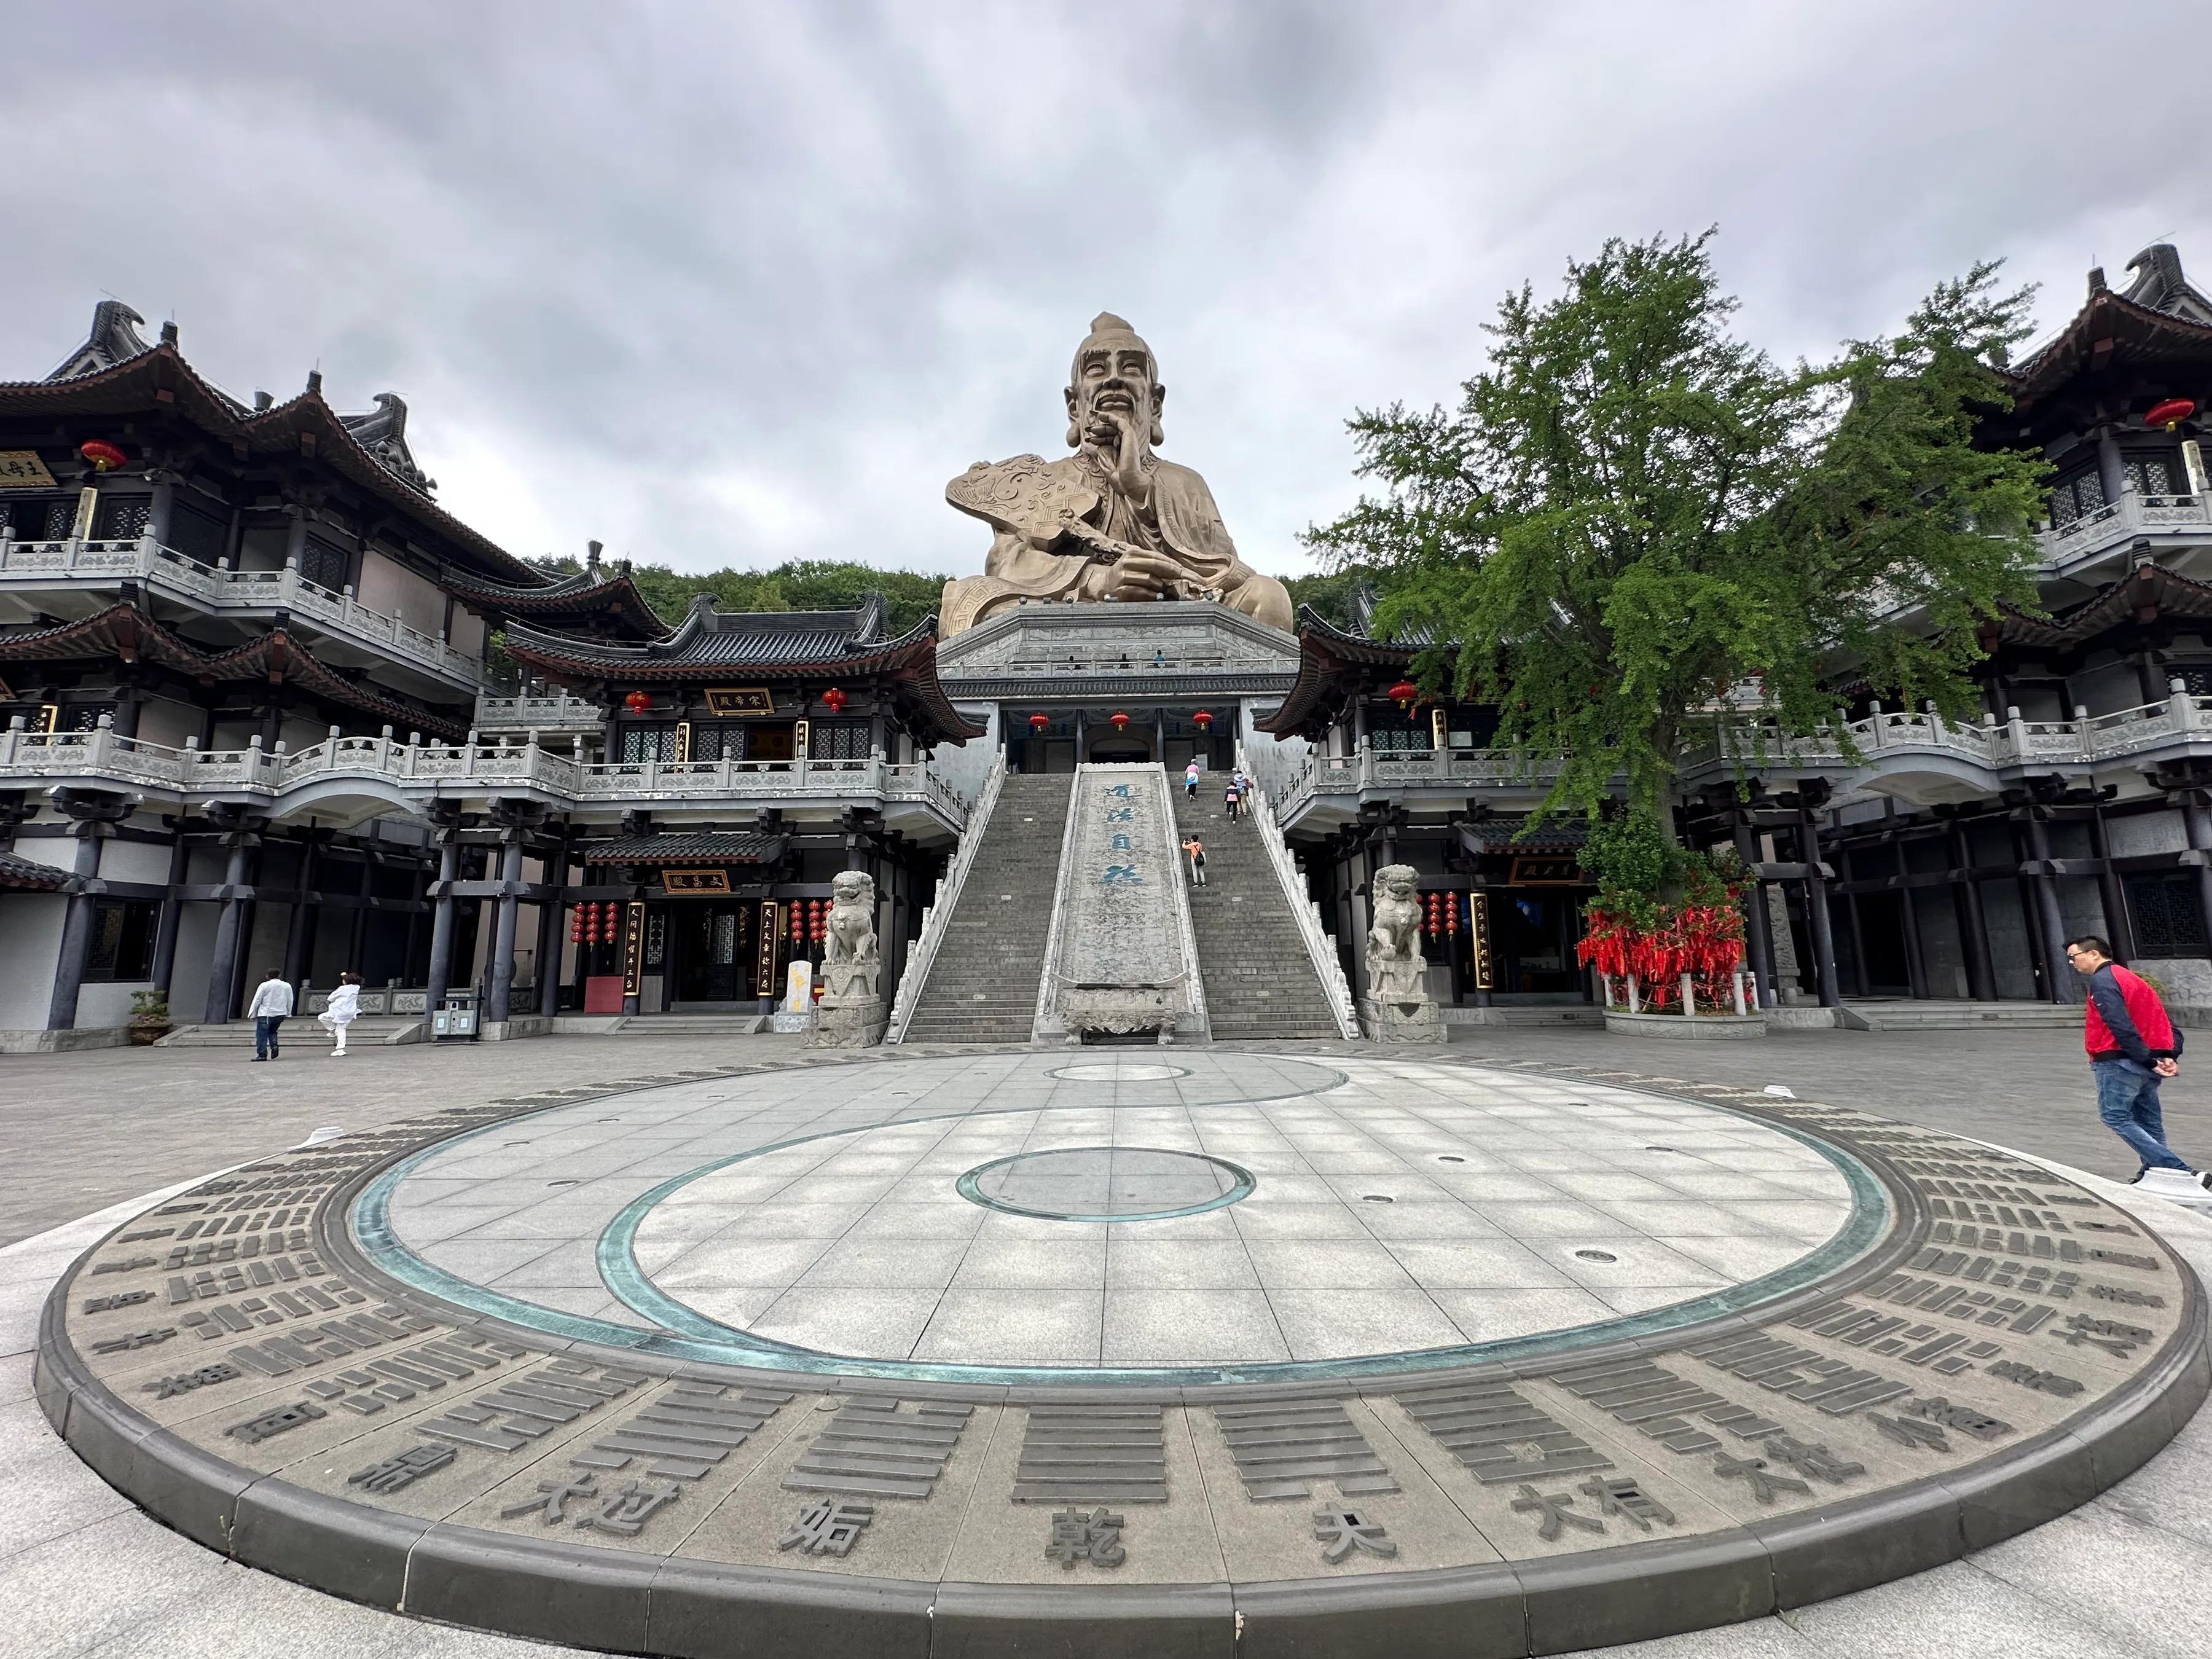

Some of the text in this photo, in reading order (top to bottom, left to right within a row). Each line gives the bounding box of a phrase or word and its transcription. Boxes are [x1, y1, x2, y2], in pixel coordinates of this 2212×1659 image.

[673, 875, 723, 887] 文昌殿
[141, 1362, 242, 1400] 巽
[223, 1400, 327, 1444] 恒
[1866, 1396, 2018, 1453] 小畜
[348, 1442, 457, 1495] 鼎
[1714, 1436, 1866, 1505] 大壮
[501, 1472, 681, 1537] 大过
[779, 1499, 874, 1558] 姤
[1312, 1502, 1398, 1565] 夬
[1510, 1474, 1677, 1542] 大有
[1045, 1507, 1126, 1570] 乾
